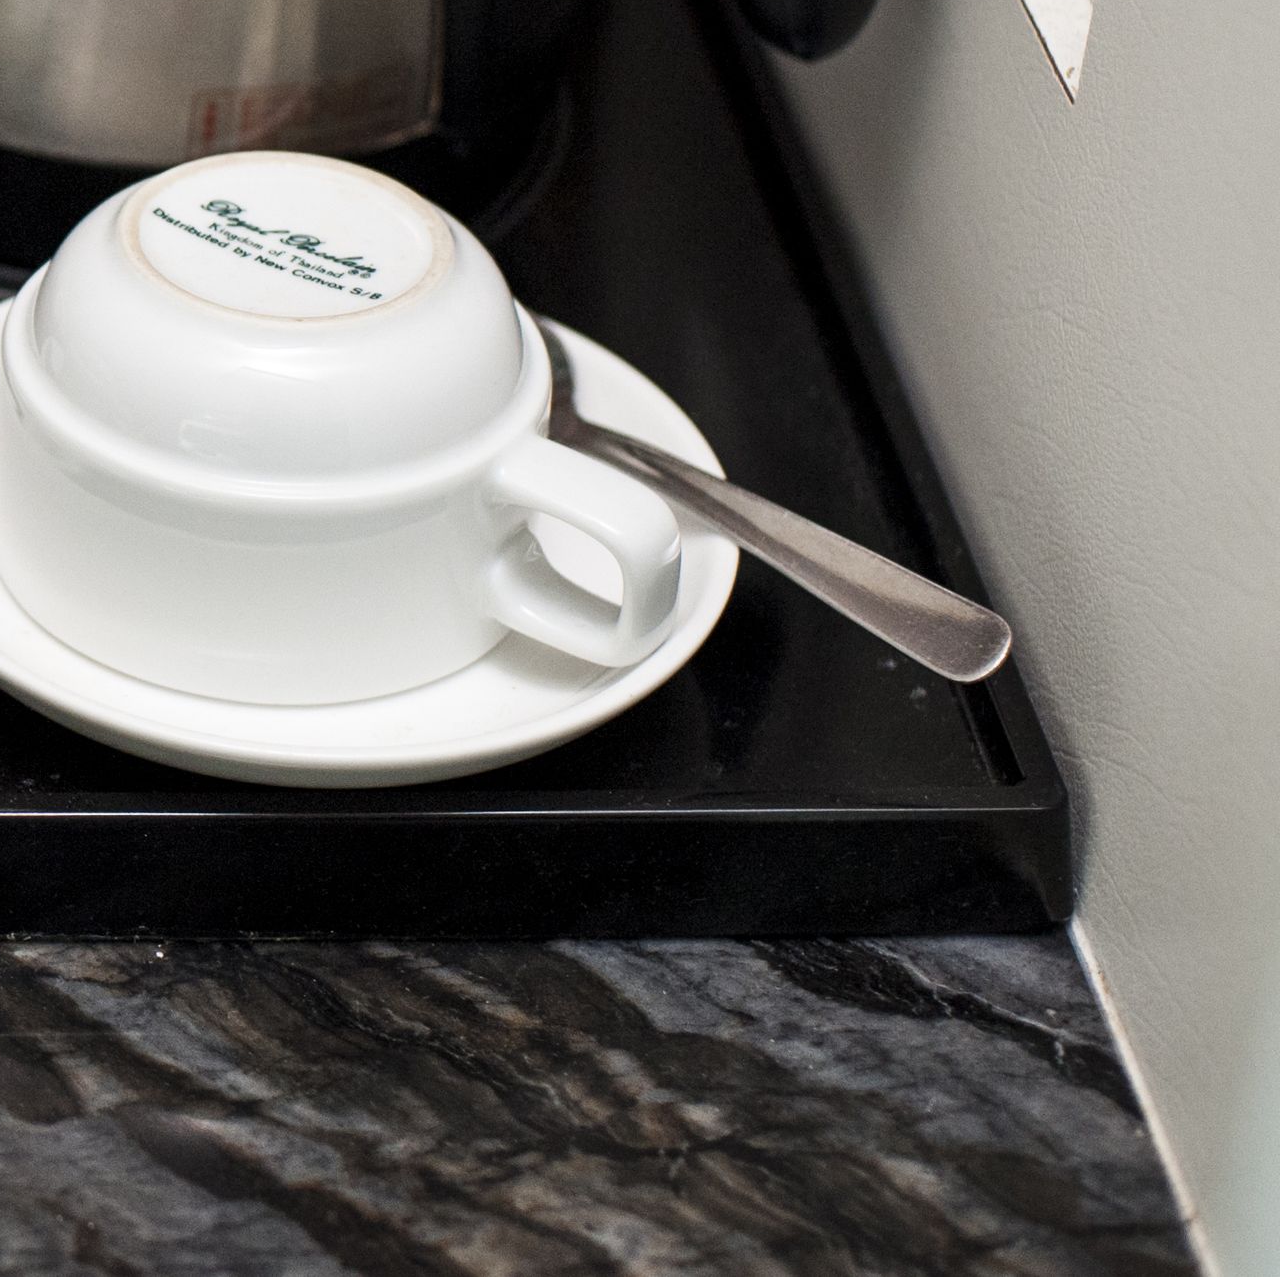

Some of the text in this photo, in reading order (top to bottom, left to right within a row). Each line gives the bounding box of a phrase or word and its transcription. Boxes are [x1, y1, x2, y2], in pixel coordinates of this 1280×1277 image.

[200, 200, 290, 235] Royal
[153, 207, 229, 248] Distributed
[233, 247, 251, 258] by
[255, 255, 287, 271] New
[350, 287, 382, 300] S/B
[208, 222, 344, 278] Kingdom of Thailand
